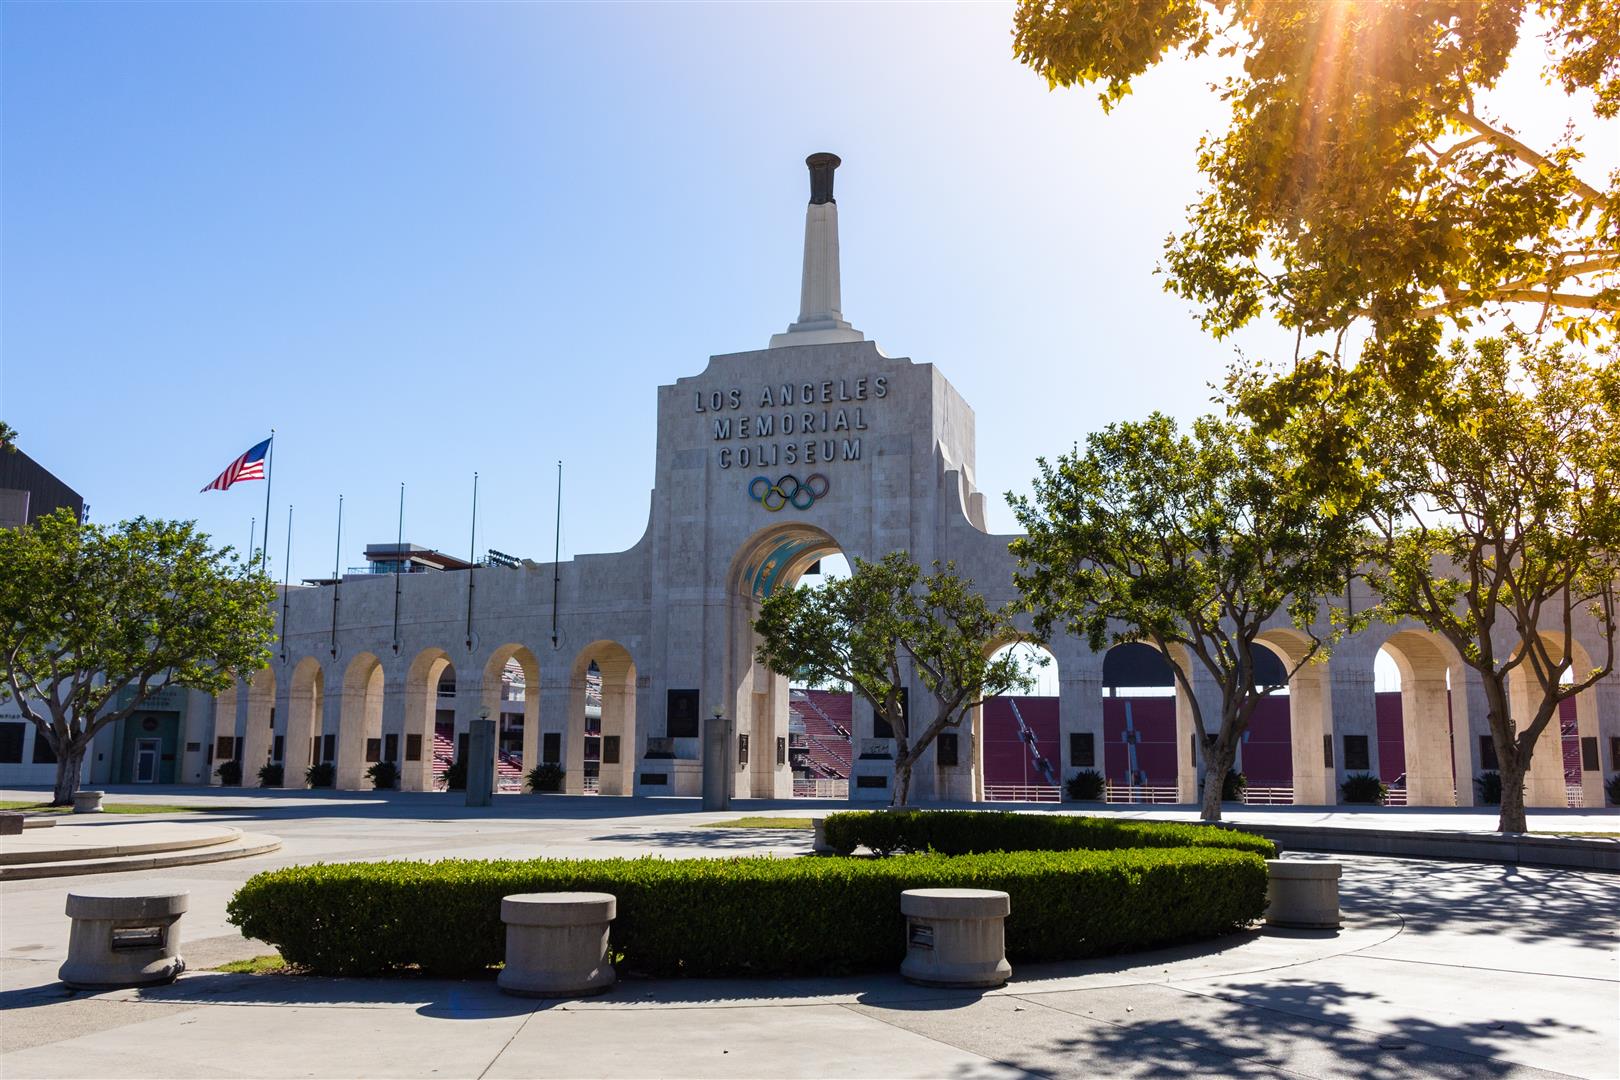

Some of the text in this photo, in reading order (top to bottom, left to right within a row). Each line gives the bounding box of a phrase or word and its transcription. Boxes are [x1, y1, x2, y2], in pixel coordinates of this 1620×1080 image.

[695, 376, 887, 413] LOS ANGELES
[714, 407, 867, 440] MEMORIAL
[719, 438, 862, 470] COLISEUM
